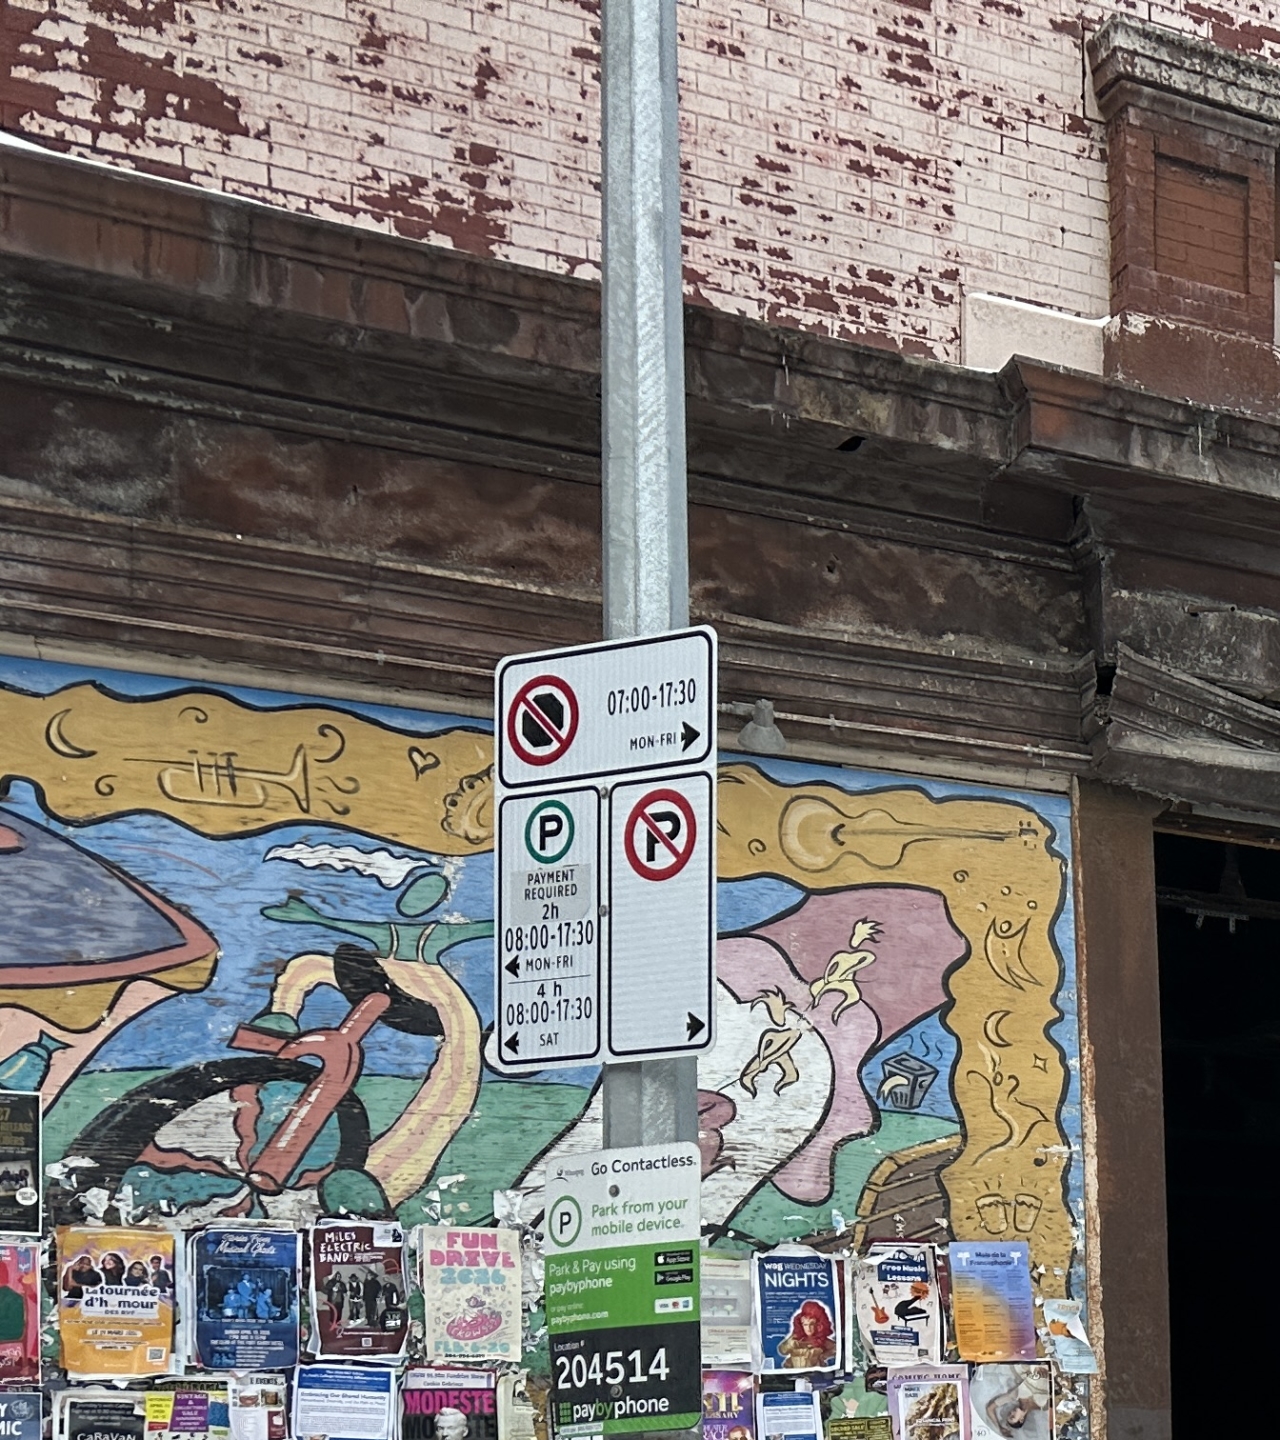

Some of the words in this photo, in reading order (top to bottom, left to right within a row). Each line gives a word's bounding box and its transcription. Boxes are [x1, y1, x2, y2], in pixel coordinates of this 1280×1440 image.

[608, 678, 696, 716] 07:00-17:30
[630, 734, 677, 751] MON-FRI
[540, 814, 562, 850] P
[527, 868, 574, 885] PAYMENT
[524, 883, 578, 900] REQUIRED
[542, 904, 559, 920] 2h
[505, 920, 594, 952] 08:00-17:30
[525, 955, 573, 971] MON-FRI
[506, 997, 593, 1026] 08:00-17:30
[539, 1033, 559, 1047] SAT
[591, 1162, 607, 1176] Go
[591, 1203, 618, 1218] Park
[622, 1201, 653, 1215] from
[658, 1199, 688, 1215] your
[591, 1221, 633, 1236] mobile
[446, 1231, 498, 1250] FUN
[430, 1249, 516, 1268] DRIVE
[549, 1263, 570, 1277] Park
[572, 1261, 580, 1274] &
[582, 1259, 602, 1275] Pay
[604, 1257, 636, 1272] using
[764, 1262, 783, 1271] wag
[784, 1262, 827, 1270] WEDNESDAY
[440, 1267, 506, 1285] 2026
[765, 1272, 829, 1288] NIGHTS
[887, 1274, 921, 1282] Lessons
[100, 1286, 157, 1297] tournée
[549, 1277, 613, 1297] paybyphone
[554, 1341, 579, 1352] Location
[556, 1347, 669, 1390] 204514
[405, 1390, 495, 1415] MODESTE
[573, 1396, 669, 1422] paybyphone
